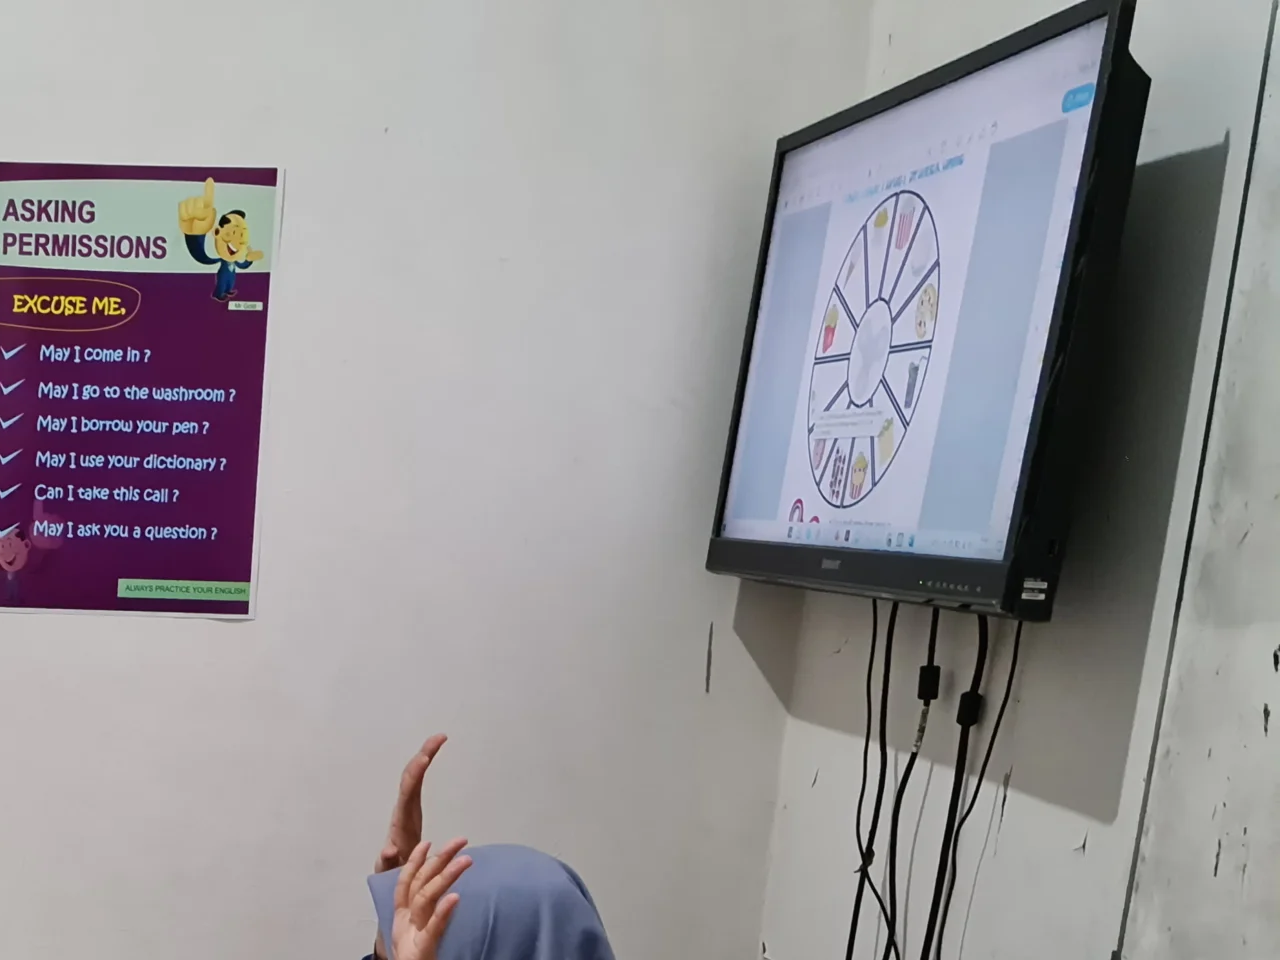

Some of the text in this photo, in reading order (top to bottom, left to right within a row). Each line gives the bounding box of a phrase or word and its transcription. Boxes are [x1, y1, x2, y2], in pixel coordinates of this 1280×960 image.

[2, 198, 96, 223] ASKING
[2, 232, 167, 260] PERMISSIONS
[12, 294, 126, 316] EXCUSE ME,
[40, 345, 70, 363] May
[74, 346, 81, 362] I
[84, 348, 123, 362] come
[127, 346, 139, 362] in
[38, 382, 69, 400] May
[72, 383, 79, 400] I
[81, 386, 100, 400] go
[103, 385, 120, 398] to
[123, 383, 148, 400] the
[152, 385, 225, 402] washroom
[37, 415, 67, 433] May
[71, 416, 77, 433] I
[81, 417, 133, 433] borrow
[136, 420, 169, 433] your
[172, 422, 199, 435] pen
[35, 451, 66, 469] May
[70, 452, 76, 468] I
[80, 455, 104, 467] use
[108, 456, 140, 469] your
[143, 455, 216, 471] dictionary
[34, 484, 63, 499] Can
[67, 485, 74, 501] I
[78, 487, 109, 500] take
[113, 487, 139, 501] this
[143, 488, 169, 503] call
[33, 520, 63, 538] May
[67, 521, 73, 538] I
[77, 523, 100, 537] ask
[104, 524, 128, 538] you
[132, 526, 141, 538] a
[145, 524, 207, 541] question
[125, 584, 153, 593] ALWAYS
[155, 585, 191, 593] PRACTICE
